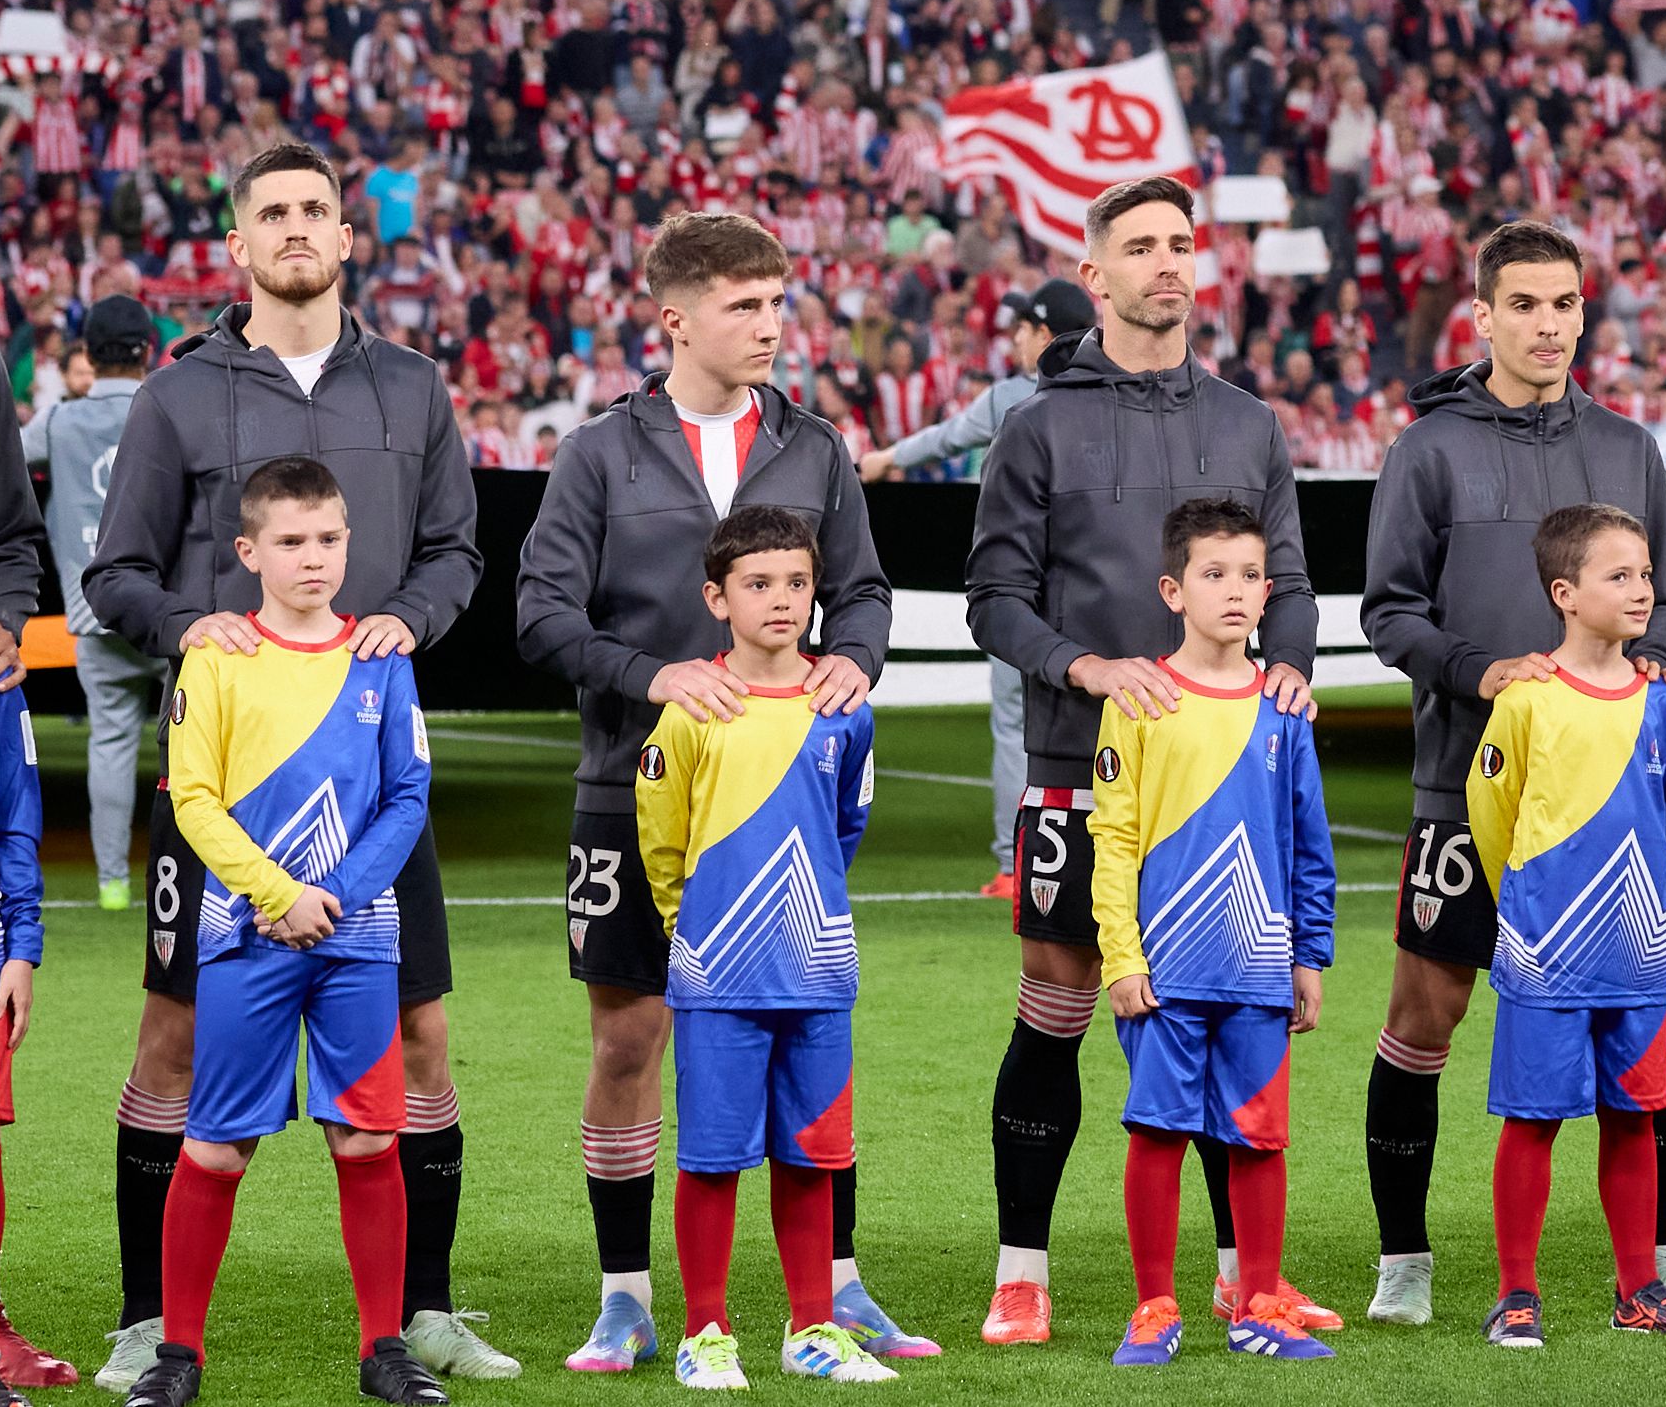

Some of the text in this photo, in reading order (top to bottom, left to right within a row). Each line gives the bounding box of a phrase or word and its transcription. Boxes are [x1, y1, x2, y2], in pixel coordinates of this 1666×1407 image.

[1032, 808, 1069, 874] 5
[1410, 824, 1473, 897] 16
[154, 855, 181, 923] 8
[568, 844, 622, 917] 23
